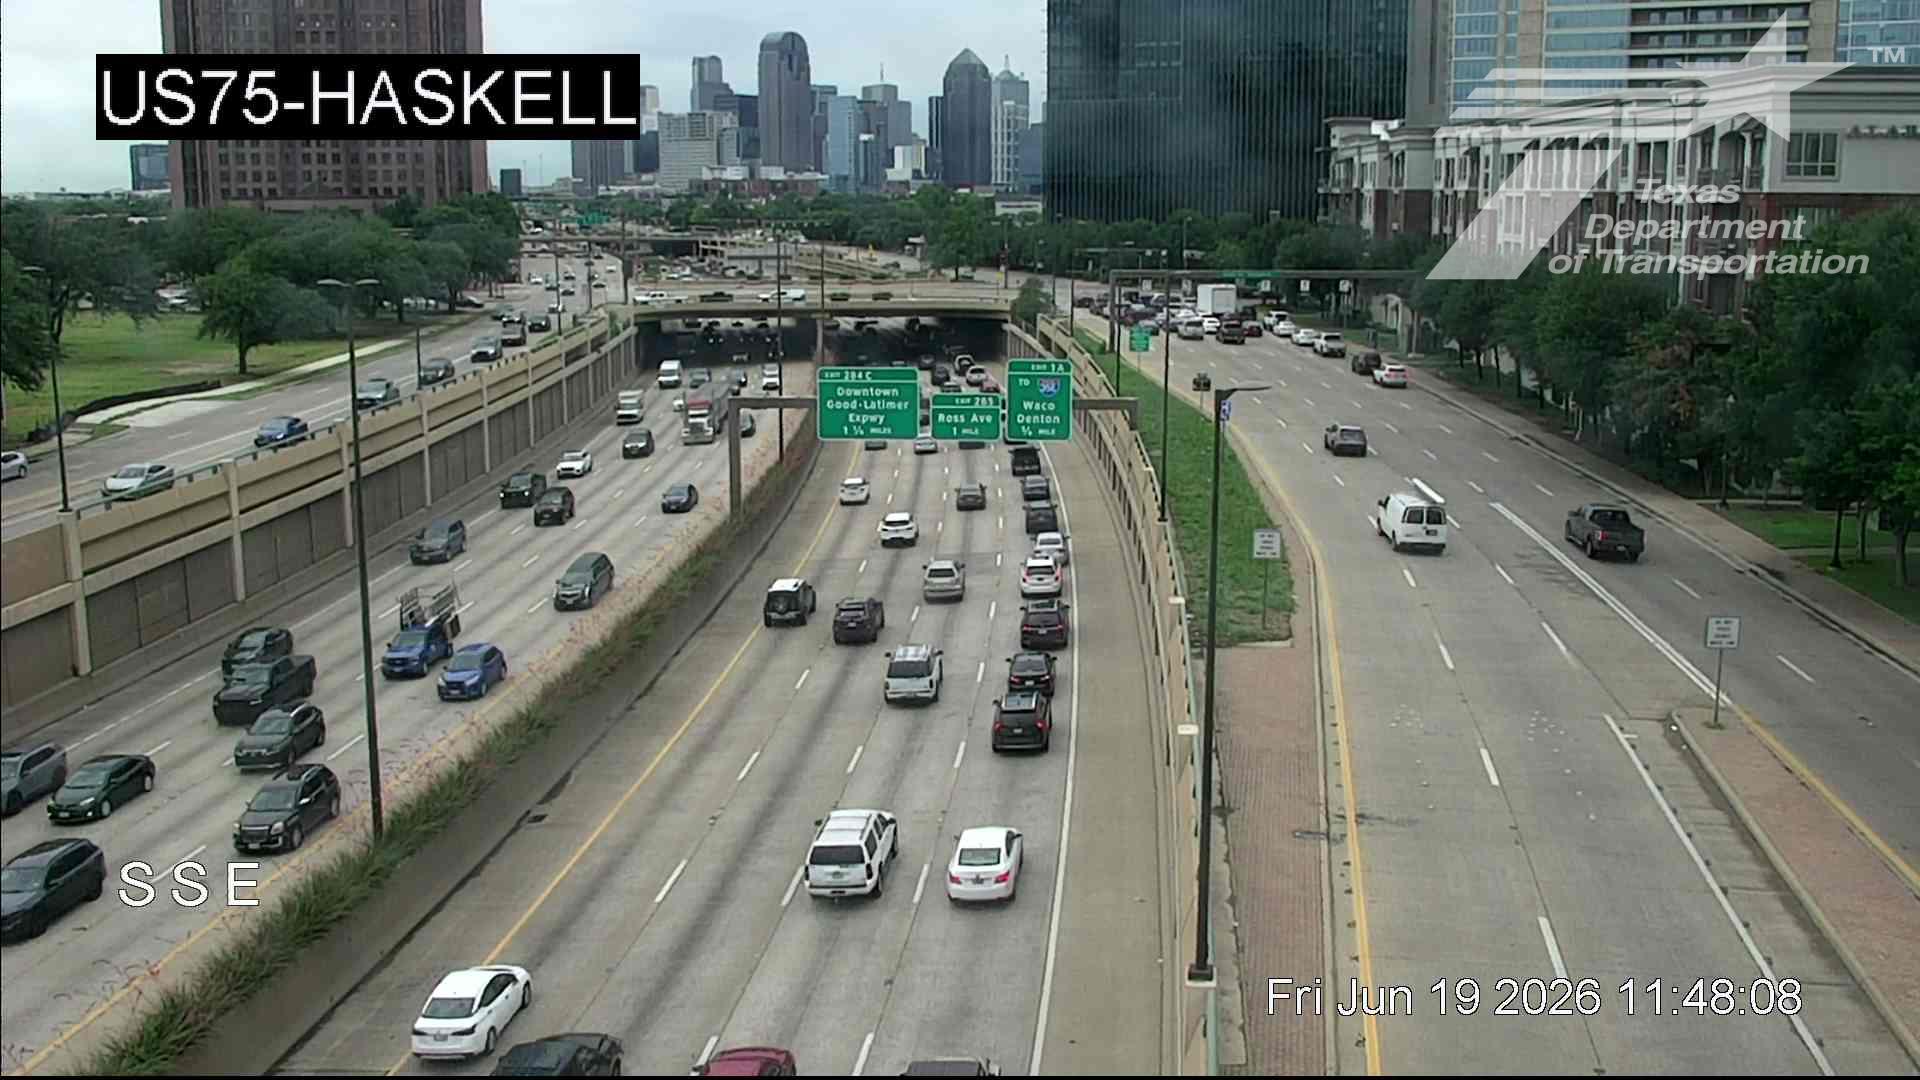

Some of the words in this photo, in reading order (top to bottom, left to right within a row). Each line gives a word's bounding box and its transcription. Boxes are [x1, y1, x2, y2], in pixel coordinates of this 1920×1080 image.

[1019, 378, 1031, 386] TO
[836, 386, 899, 396] Downtown
[1022, 400, 1056, 411] Waco
[848, 413, 885, 425] Expwy
[937, 412, 965, 423] Ross
[970, 412, 993, 423] Ave
[1016, 413, 1061, 424] Denton
